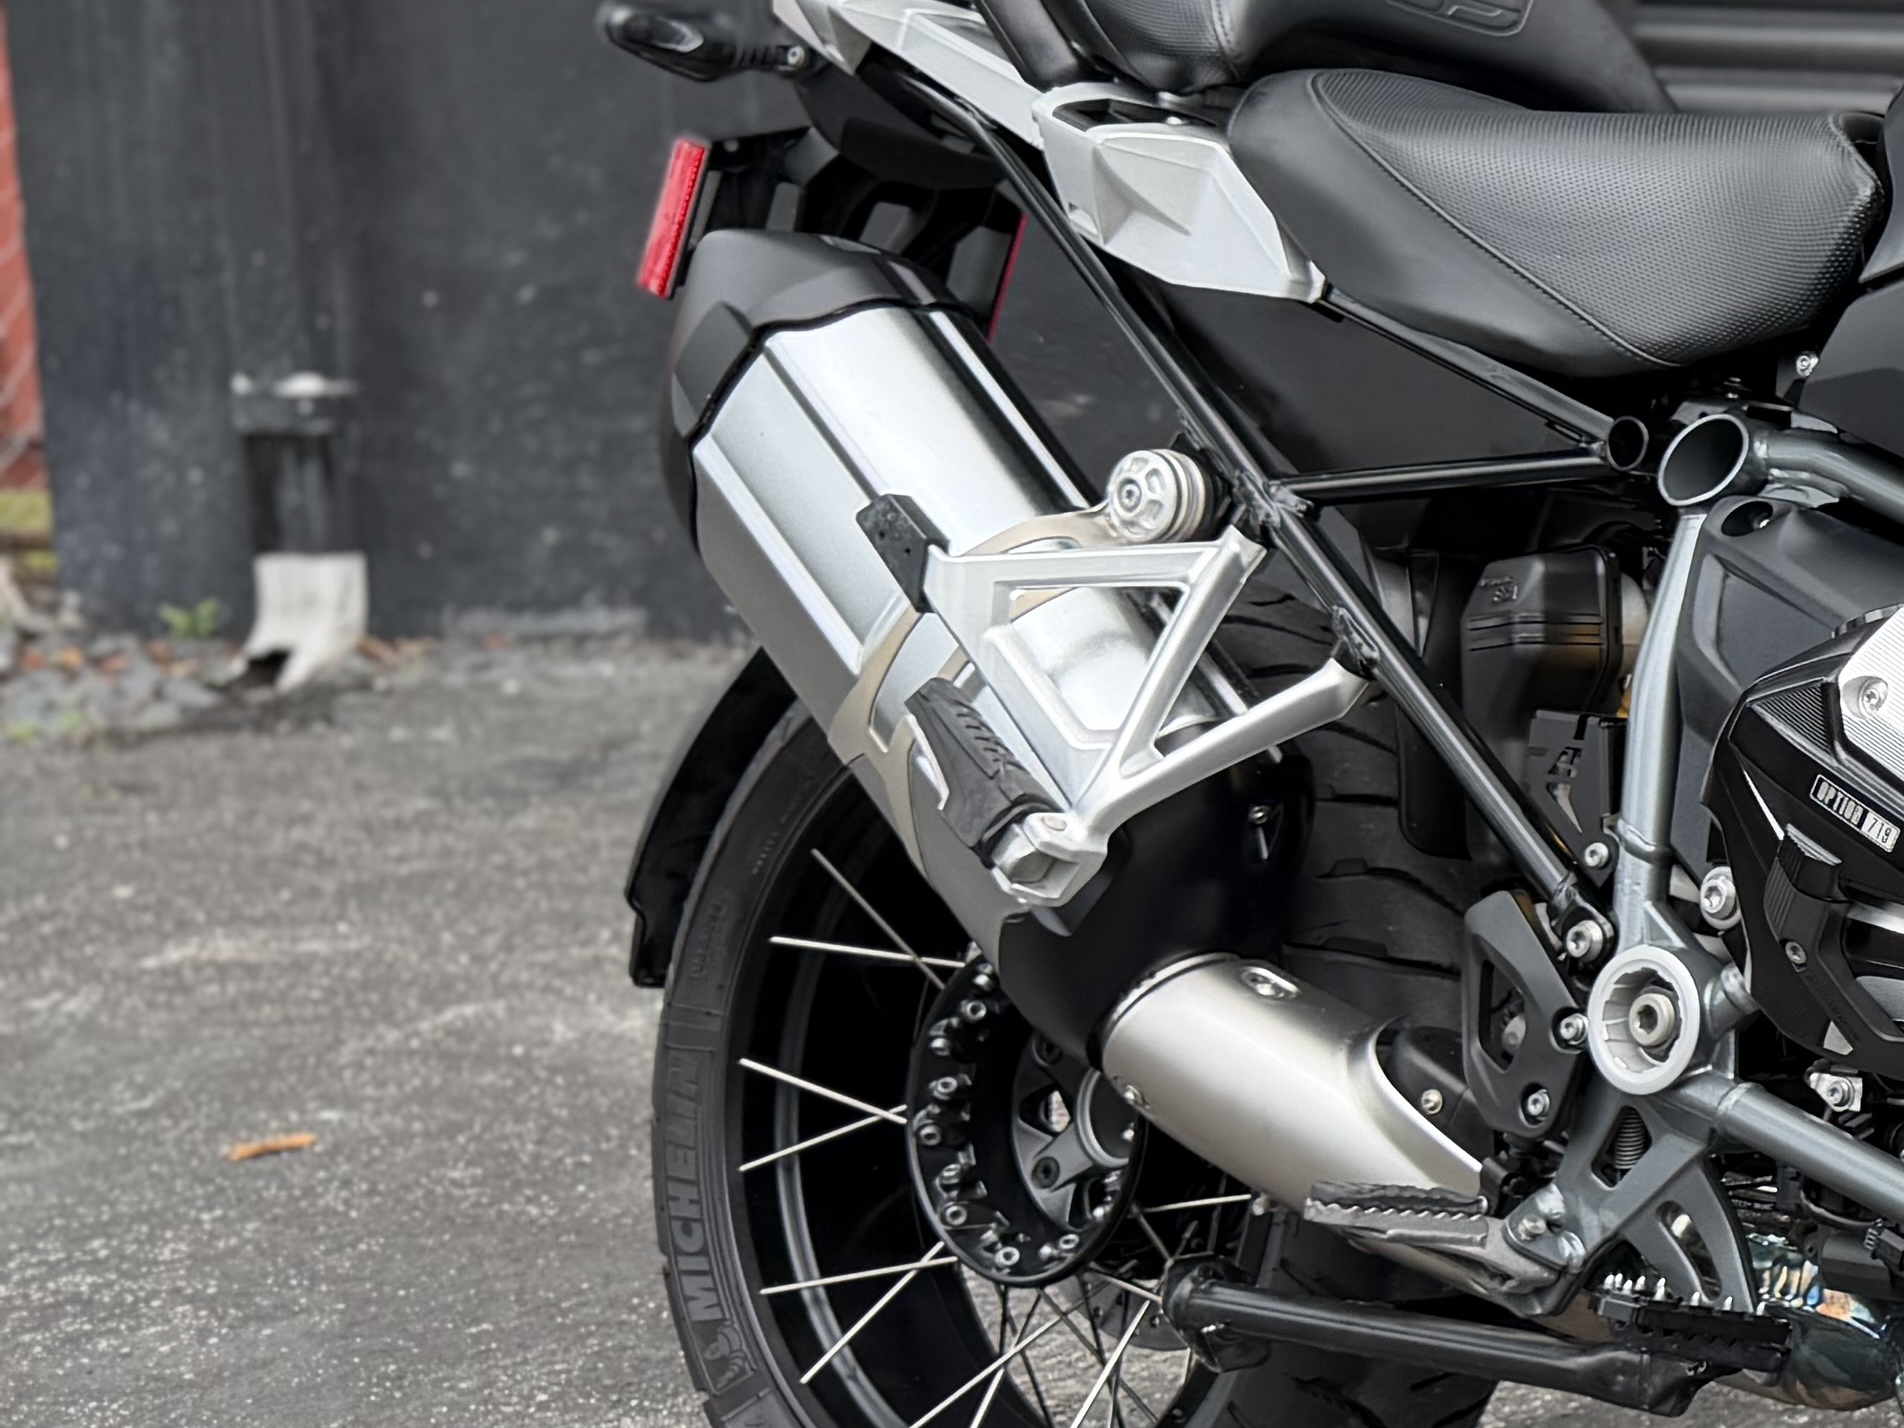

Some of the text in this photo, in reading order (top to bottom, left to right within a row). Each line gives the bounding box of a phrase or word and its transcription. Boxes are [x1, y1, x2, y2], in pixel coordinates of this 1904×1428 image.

[1816, 781, 1892, 844] OPTION 719
[666, 1049, 728, 1322] MICHELIN
